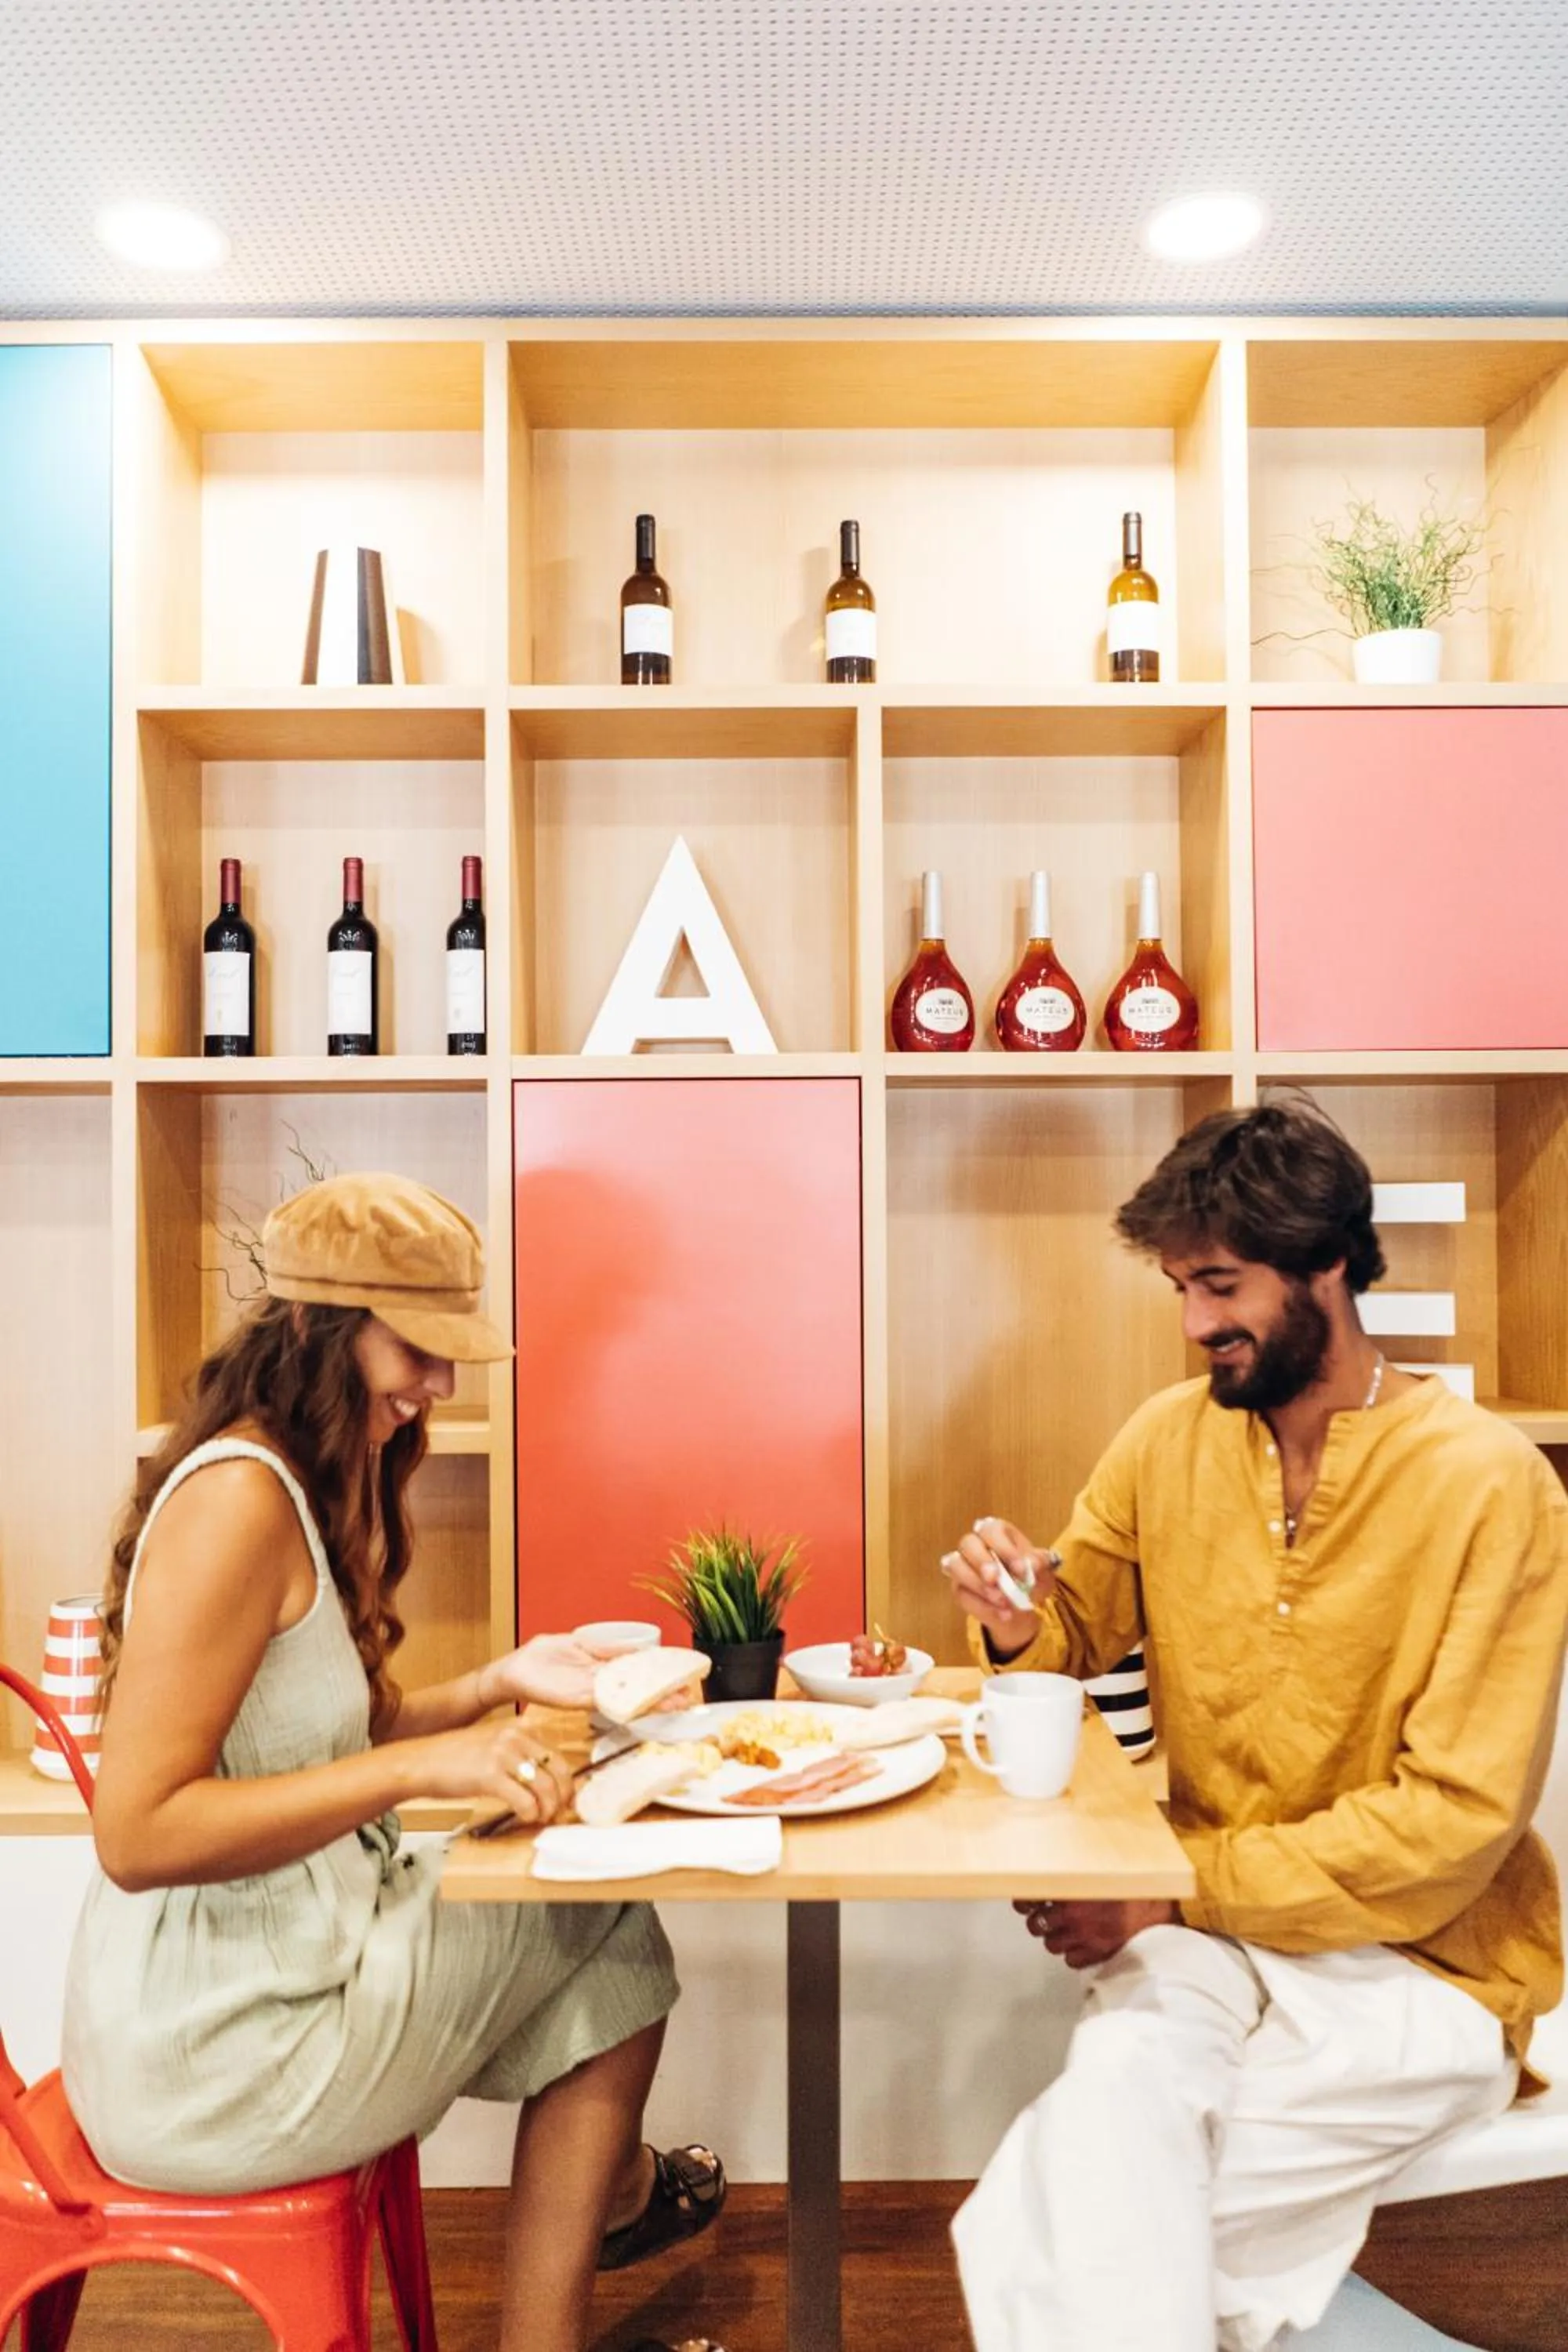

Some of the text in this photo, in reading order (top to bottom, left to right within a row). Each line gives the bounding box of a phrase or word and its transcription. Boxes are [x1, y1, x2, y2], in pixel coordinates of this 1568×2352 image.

[580, 833, 779, 1055] A
[926, 1007, 964, 1017] MATEUS
[1025, 1006, 1068, 1015] MATEUS
[1128, 1006, 1172, 1014] MATEUS
